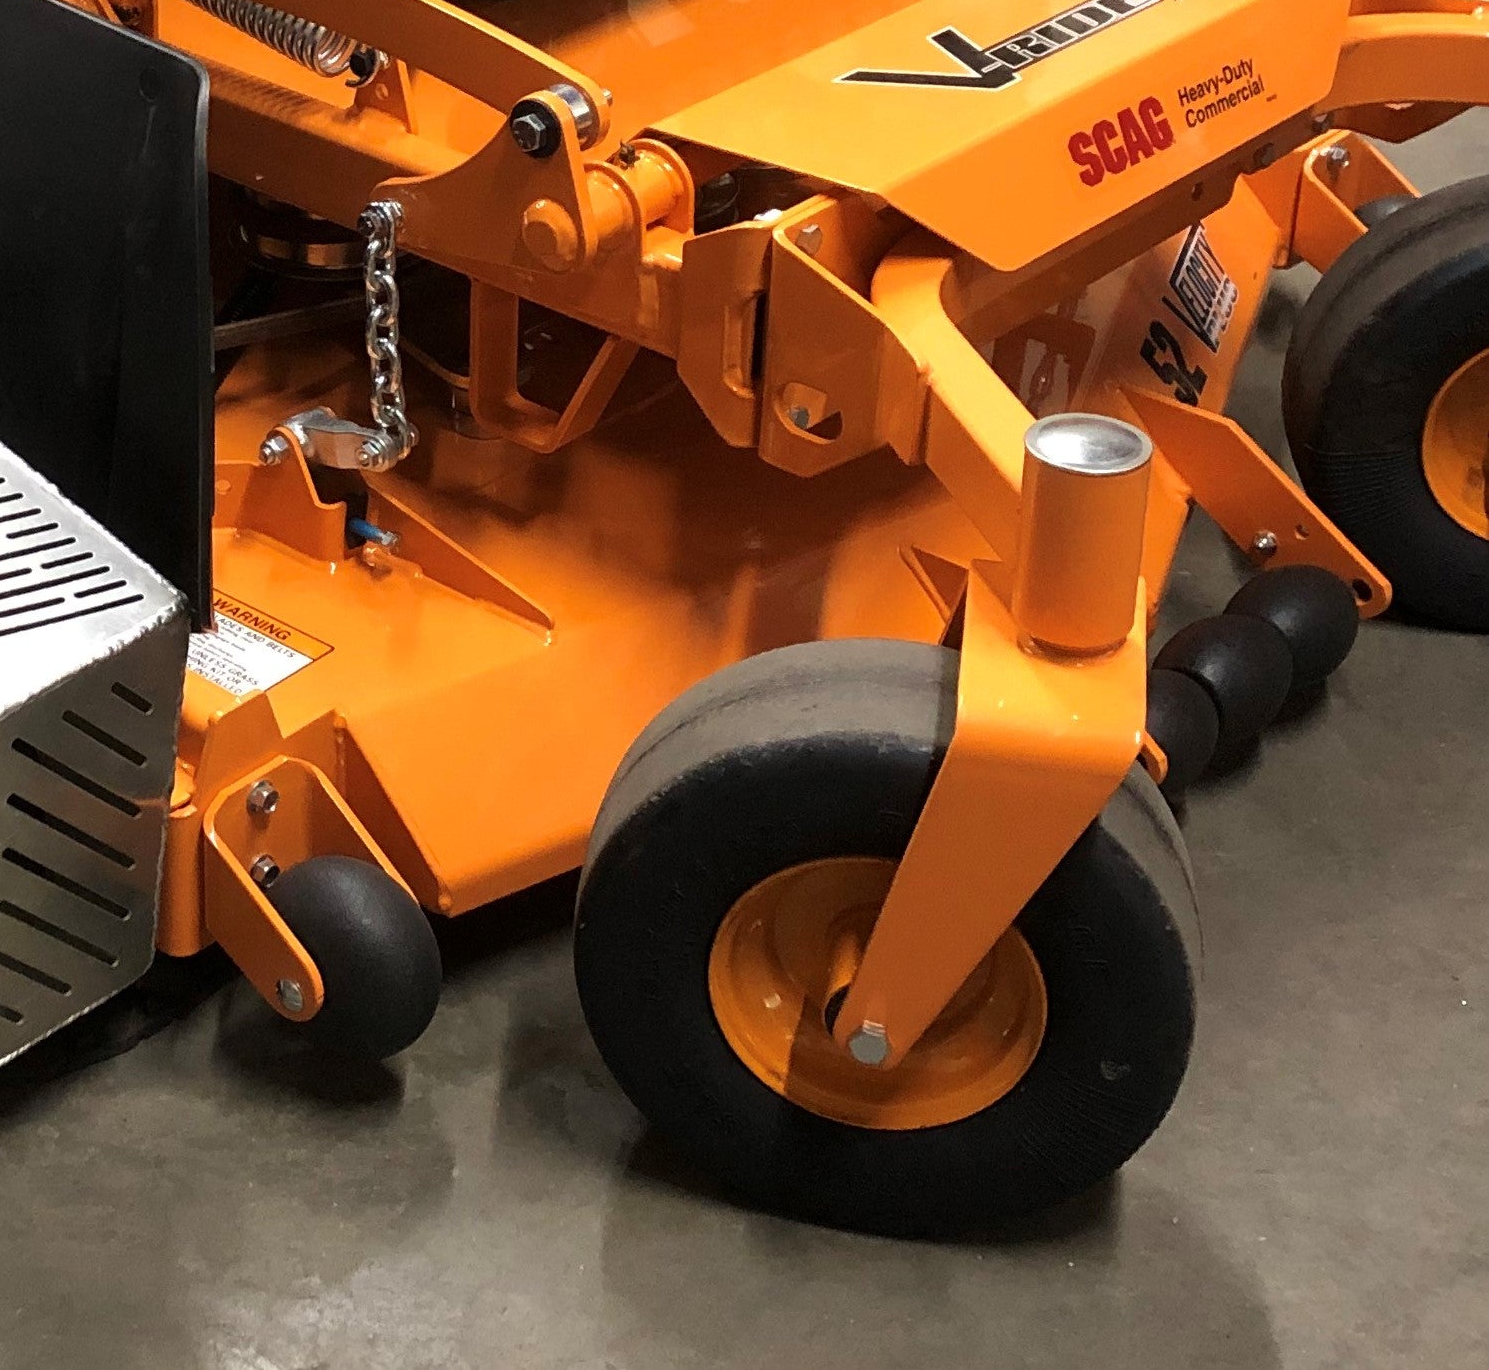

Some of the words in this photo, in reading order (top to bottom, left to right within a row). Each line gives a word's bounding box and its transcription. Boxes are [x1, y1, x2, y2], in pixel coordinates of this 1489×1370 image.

[1177, 58, 1254, 108] Heavy-Duty
[1185, 74, 1265, 128] Commercial
[1067, 96, 1175, 187] SCAG
[1140, 319, 1209, 407] 52
[212, 597, 292, 642] WARNING
[265, 640, 296, 659] BELTS
